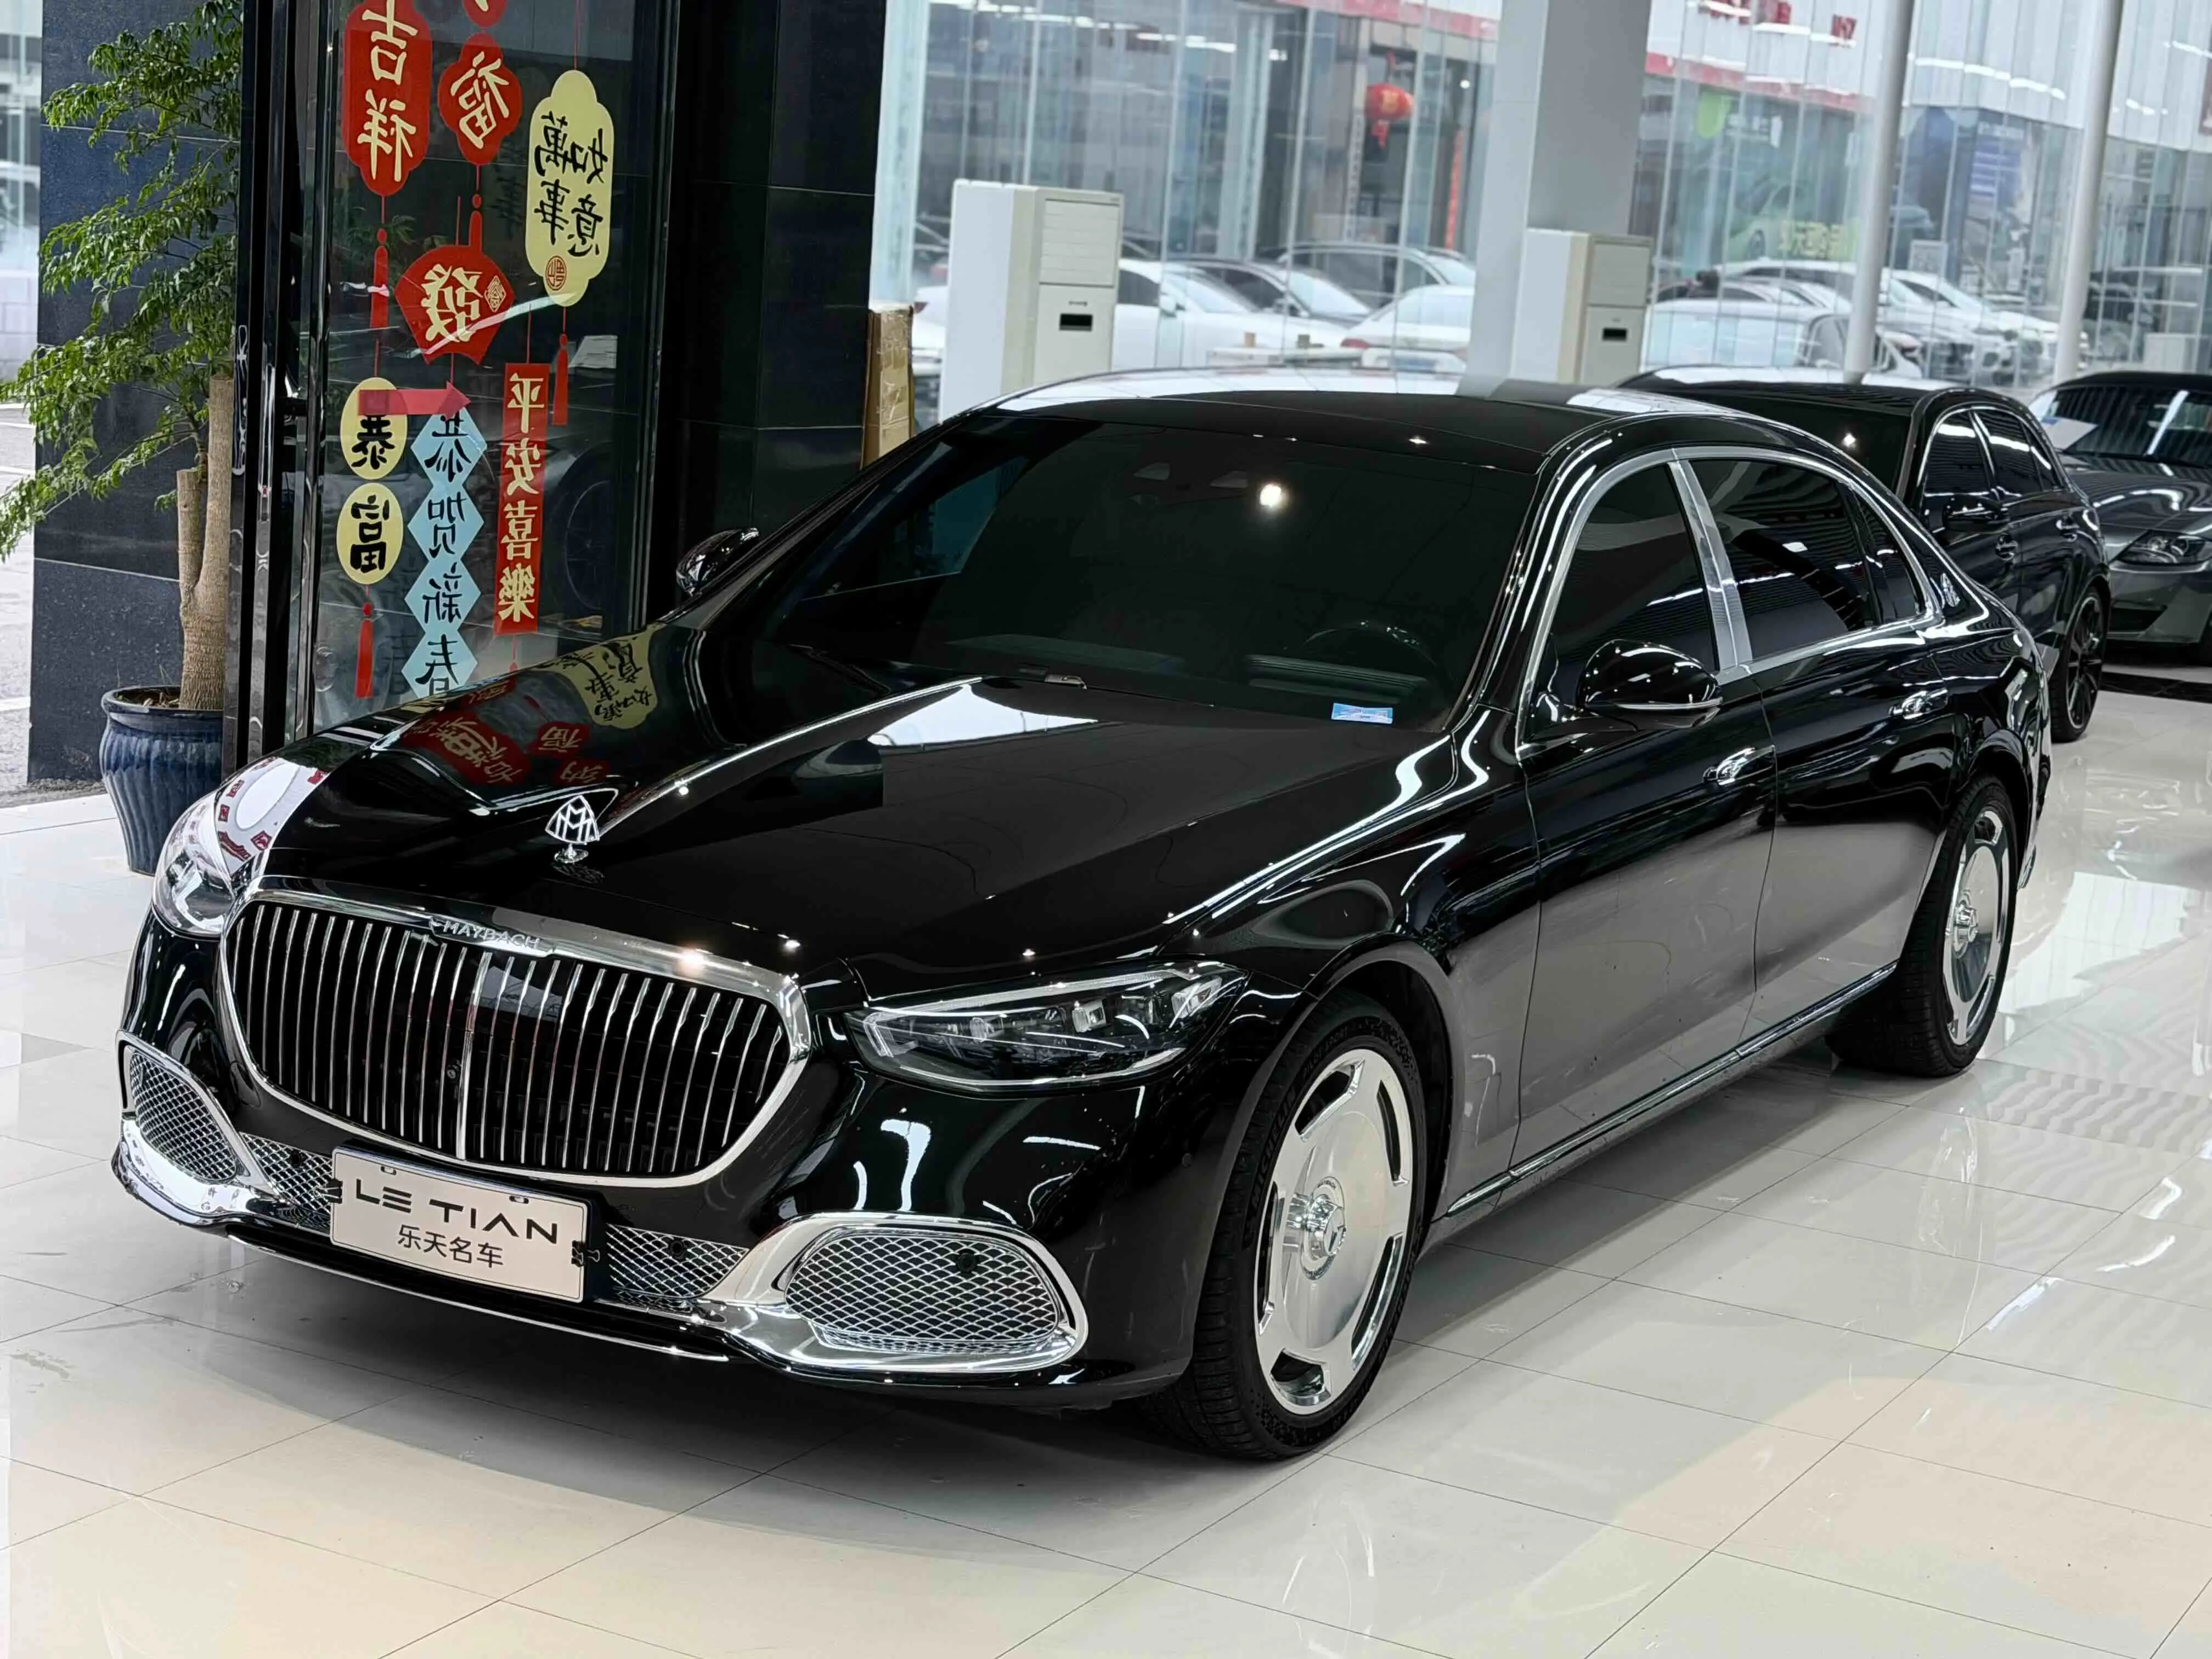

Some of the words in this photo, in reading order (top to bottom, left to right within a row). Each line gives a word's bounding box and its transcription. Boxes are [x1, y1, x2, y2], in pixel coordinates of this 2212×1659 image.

[443, 920, 541, 950] MAYBACH
[356, 1178, 412, 1214] LE
[397, 1224, 503, 1268] 乐天名车
